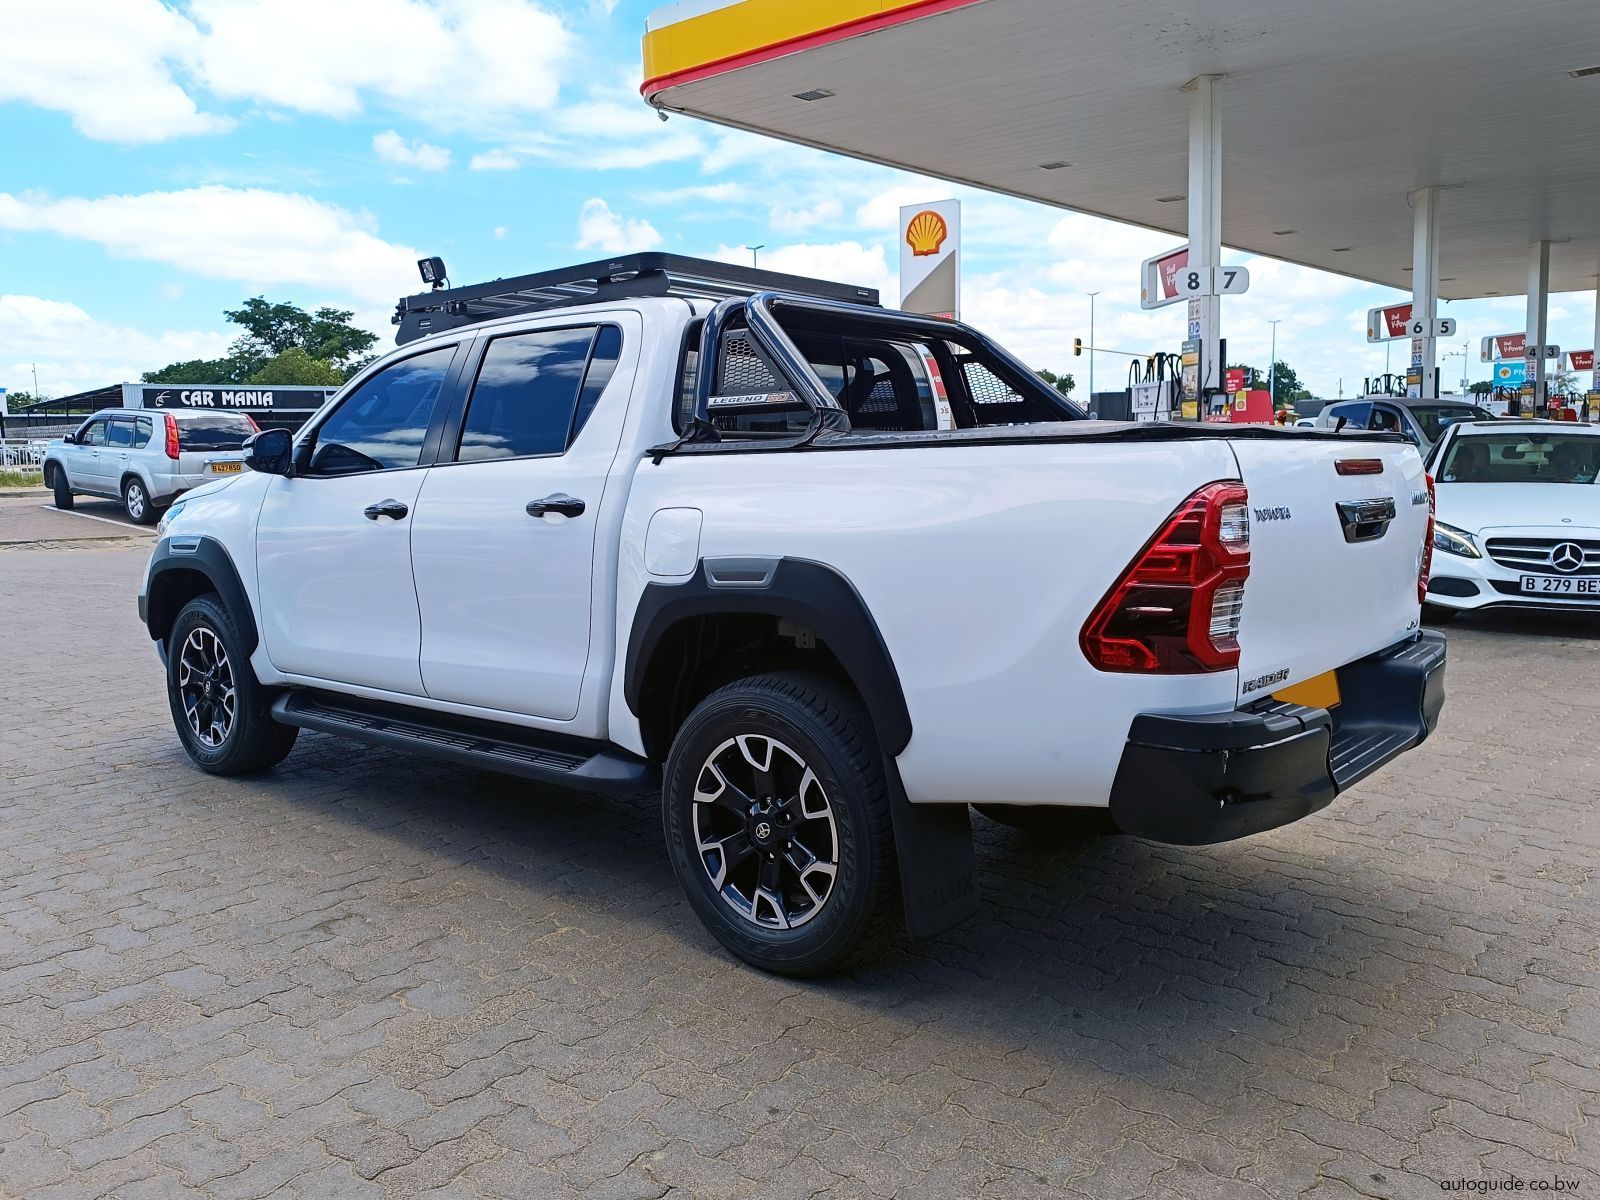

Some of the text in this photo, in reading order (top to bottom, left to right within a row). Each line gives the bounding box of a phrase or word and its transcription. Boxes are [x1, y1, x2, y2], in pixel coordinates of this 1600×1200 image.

[1187, 272, 1200, 290] 8
[1223, 271, 1237, 289] 7
[1413, 321, 1423, 334] 6
[1440, 321, 1449, 334] 5
[1529, 348, 1536, 357] 4
[1547, 347, 1555, 357] 3
[180, 390, 274, 407] CAR MANIA
[713, 395, 763, 404] LEGEND
[1254, 505, 1292, 522] TOYOTA
[1525, 577, 1600, 593] B 279 BE
[1242, 668, 1290, 695] RAIDER
